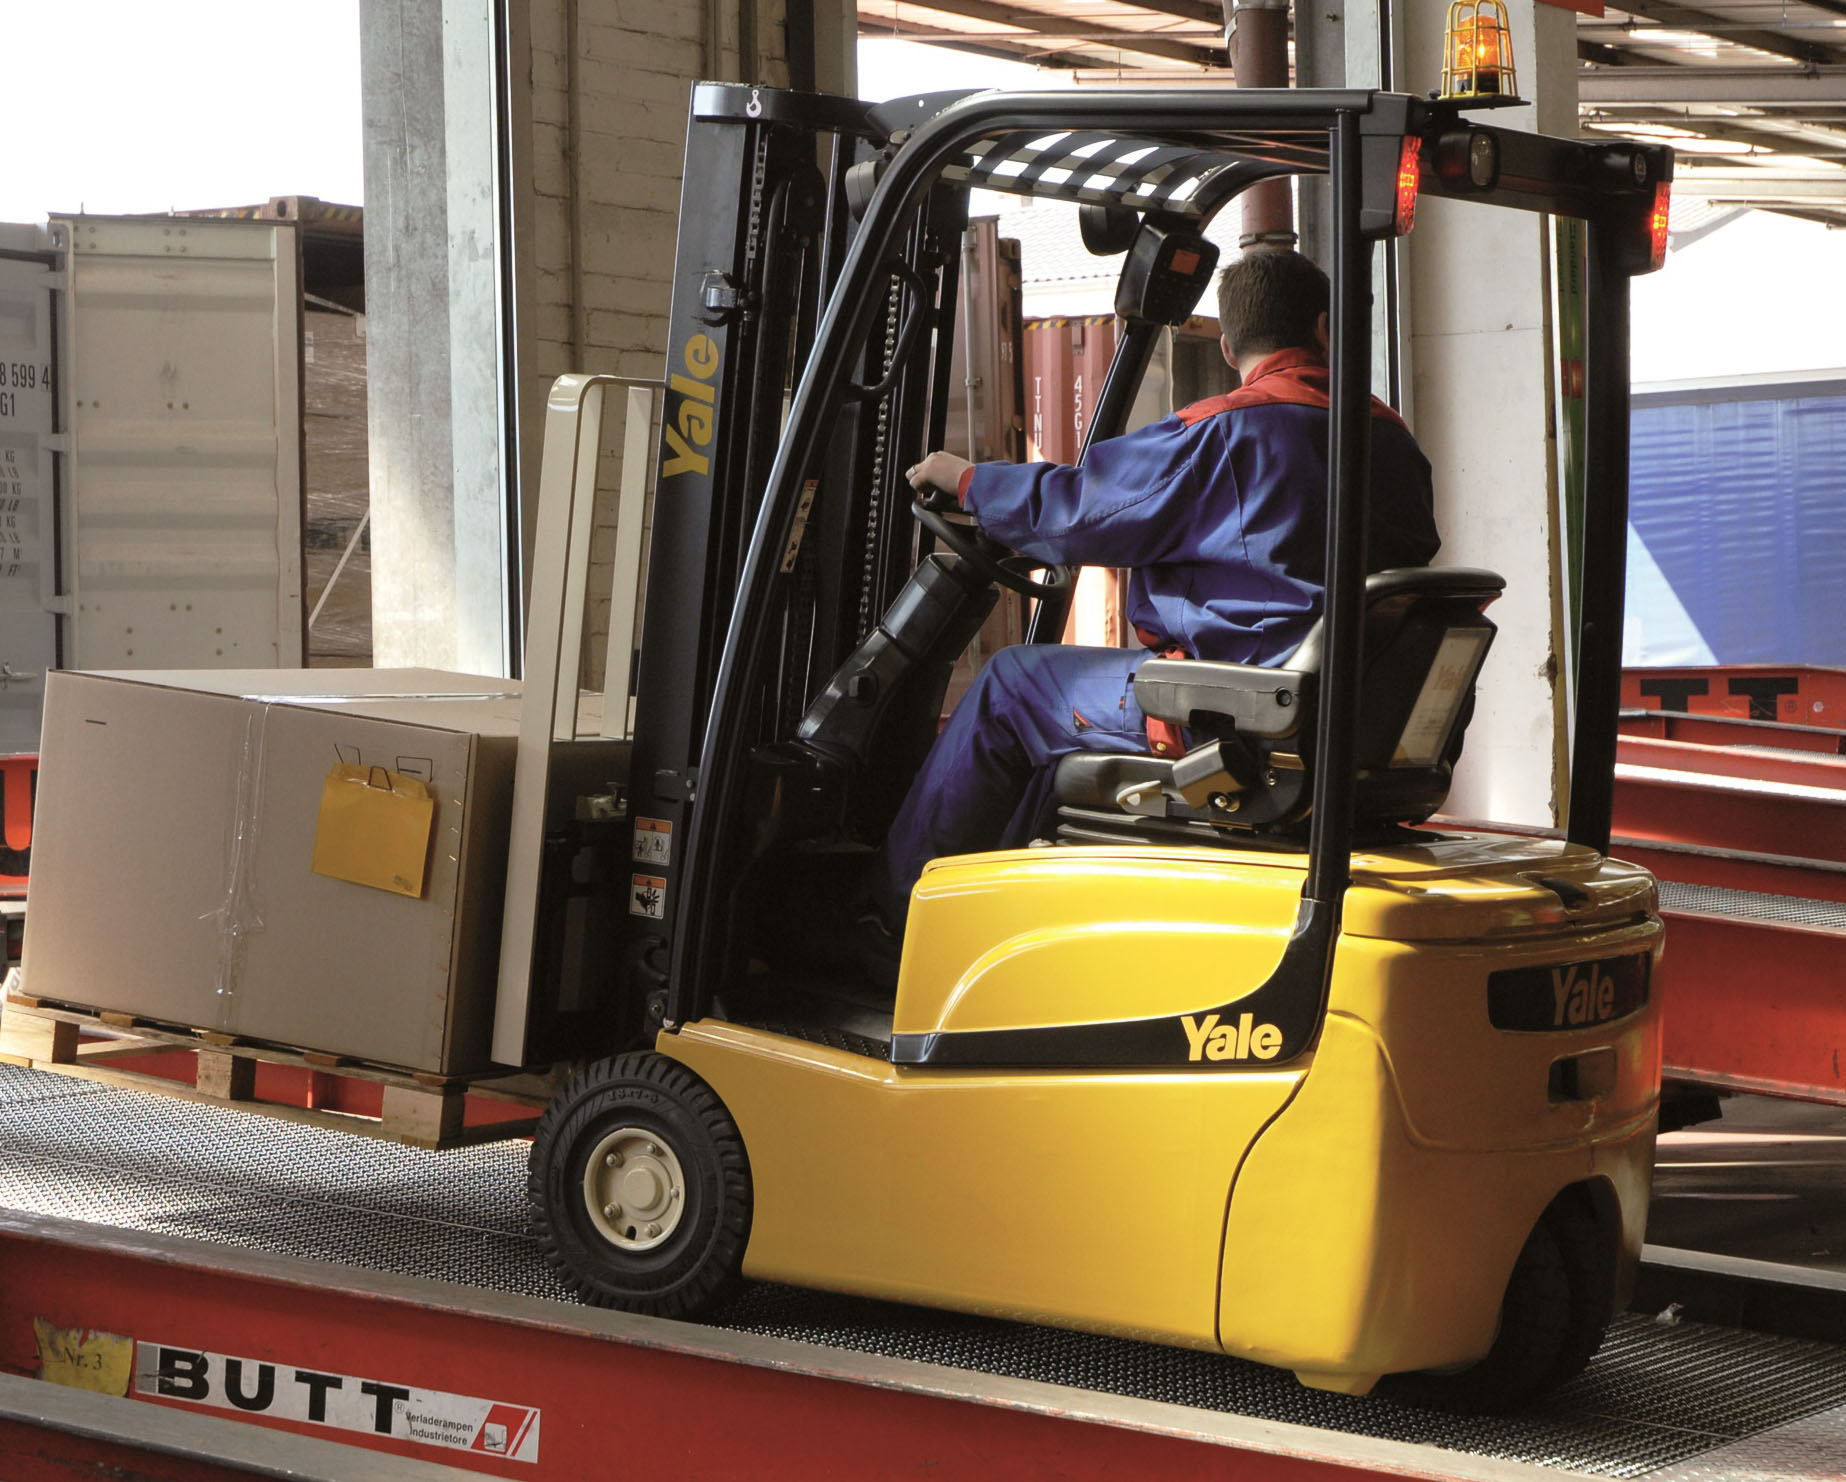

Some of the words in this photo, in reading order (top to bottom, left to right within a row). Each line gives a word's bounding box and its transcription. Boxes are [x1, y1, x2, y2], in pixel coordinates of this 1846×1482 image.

[11, 363, 36, 389] 599
[41, 365, 51, 390] 4
[662, 333, 719, 478] Yale
[1074, 375, 1083, 449] 45G1
[12, 482, 22, 496] KG
[1552, 963, 1614, 1026] Yale
[1180, 1013, 1283, 1061] Yale
[64, 1346, 89, 1368] Nr.
[92, 1353, 103, 1371] 3
[157, 1347, 410, 1435] BUTT
[406, 1411, 474, 1433] Verladerampen
[409, 1426, 468, 1446] Industrietore
